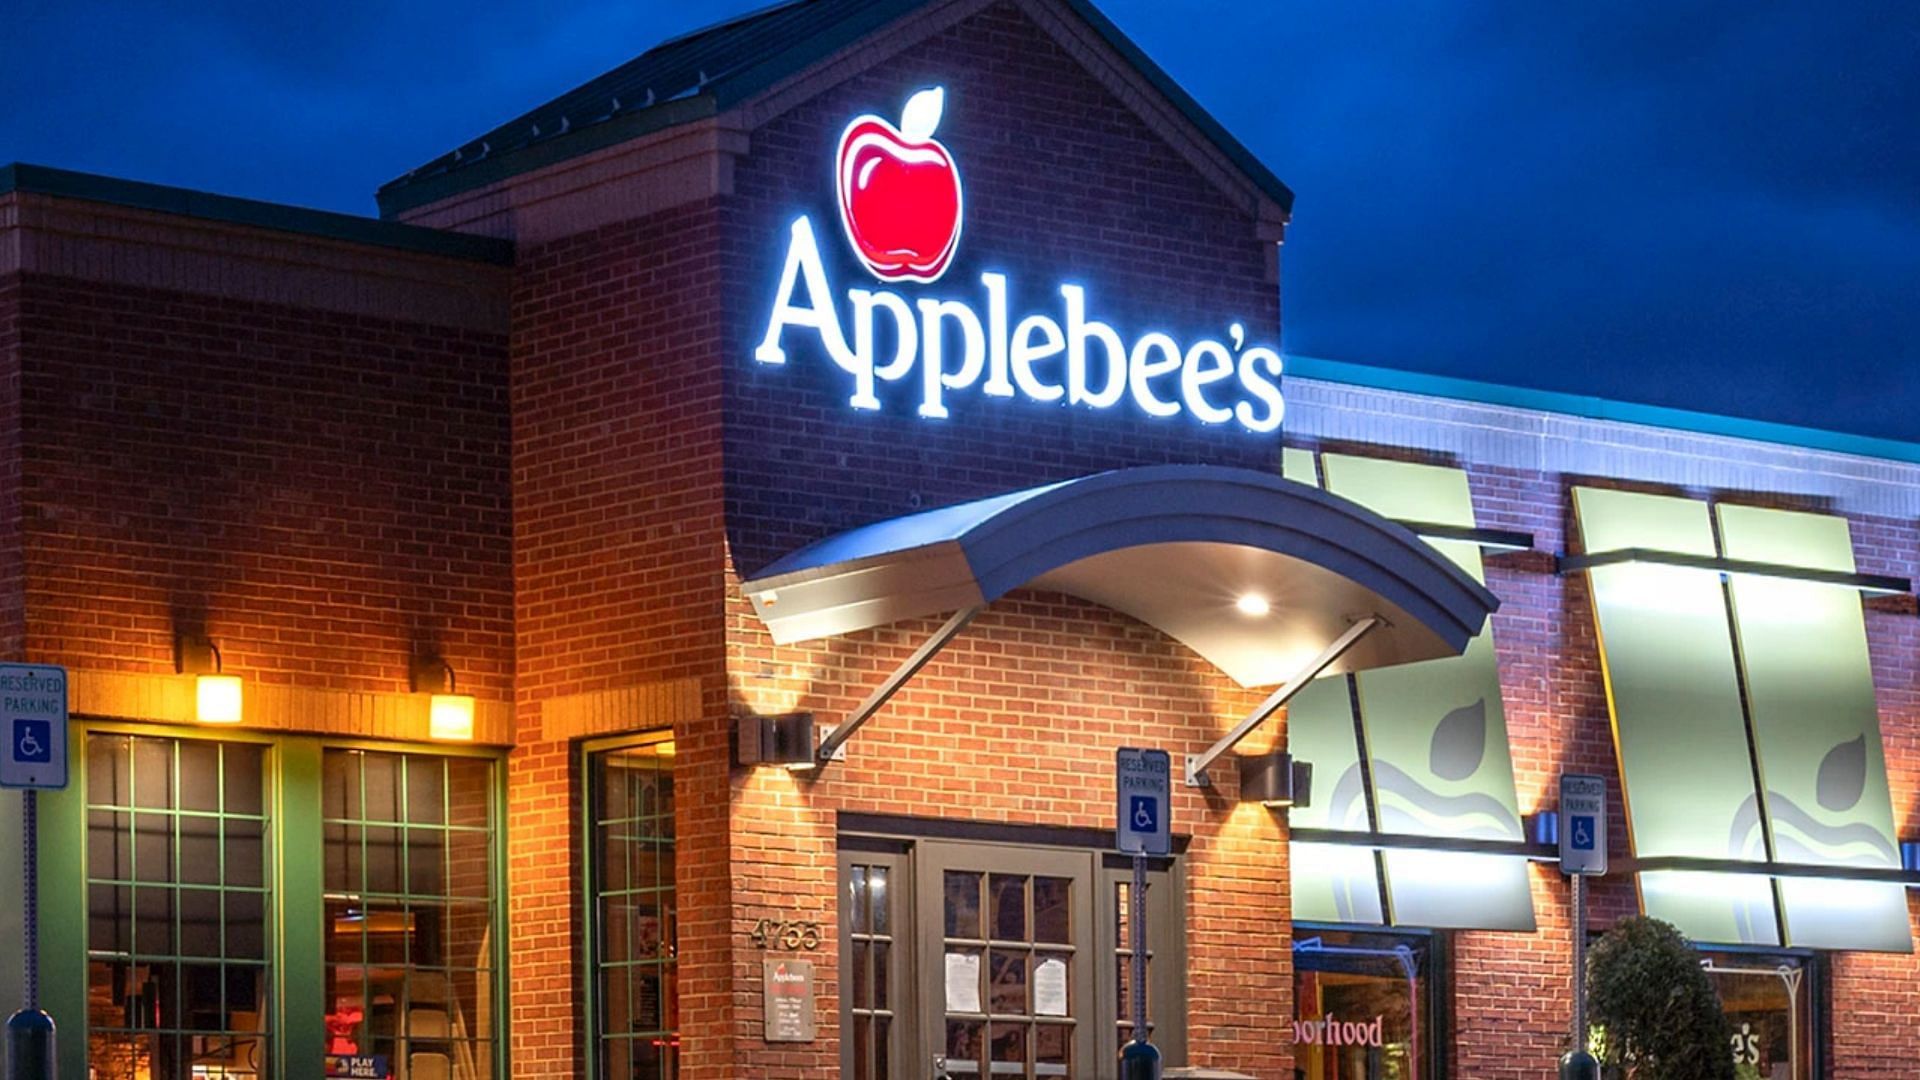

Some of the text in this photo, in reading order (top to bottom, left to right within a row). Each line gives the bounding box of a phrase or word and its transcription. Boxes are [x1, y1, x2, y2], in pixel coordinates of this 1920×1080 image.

[755, 215, 1285, 433] Applebee's
[1, 676, 61, 692] RESERVED
[4, 697, 59, 714] PARKING
[1120, 758, 1166, 773] RESERVED
[1123, 776, 1164, 792] PARKING
[1566, 798, 1600, 812] PARKING
[351, 1057, 374, 1067] PLAY
